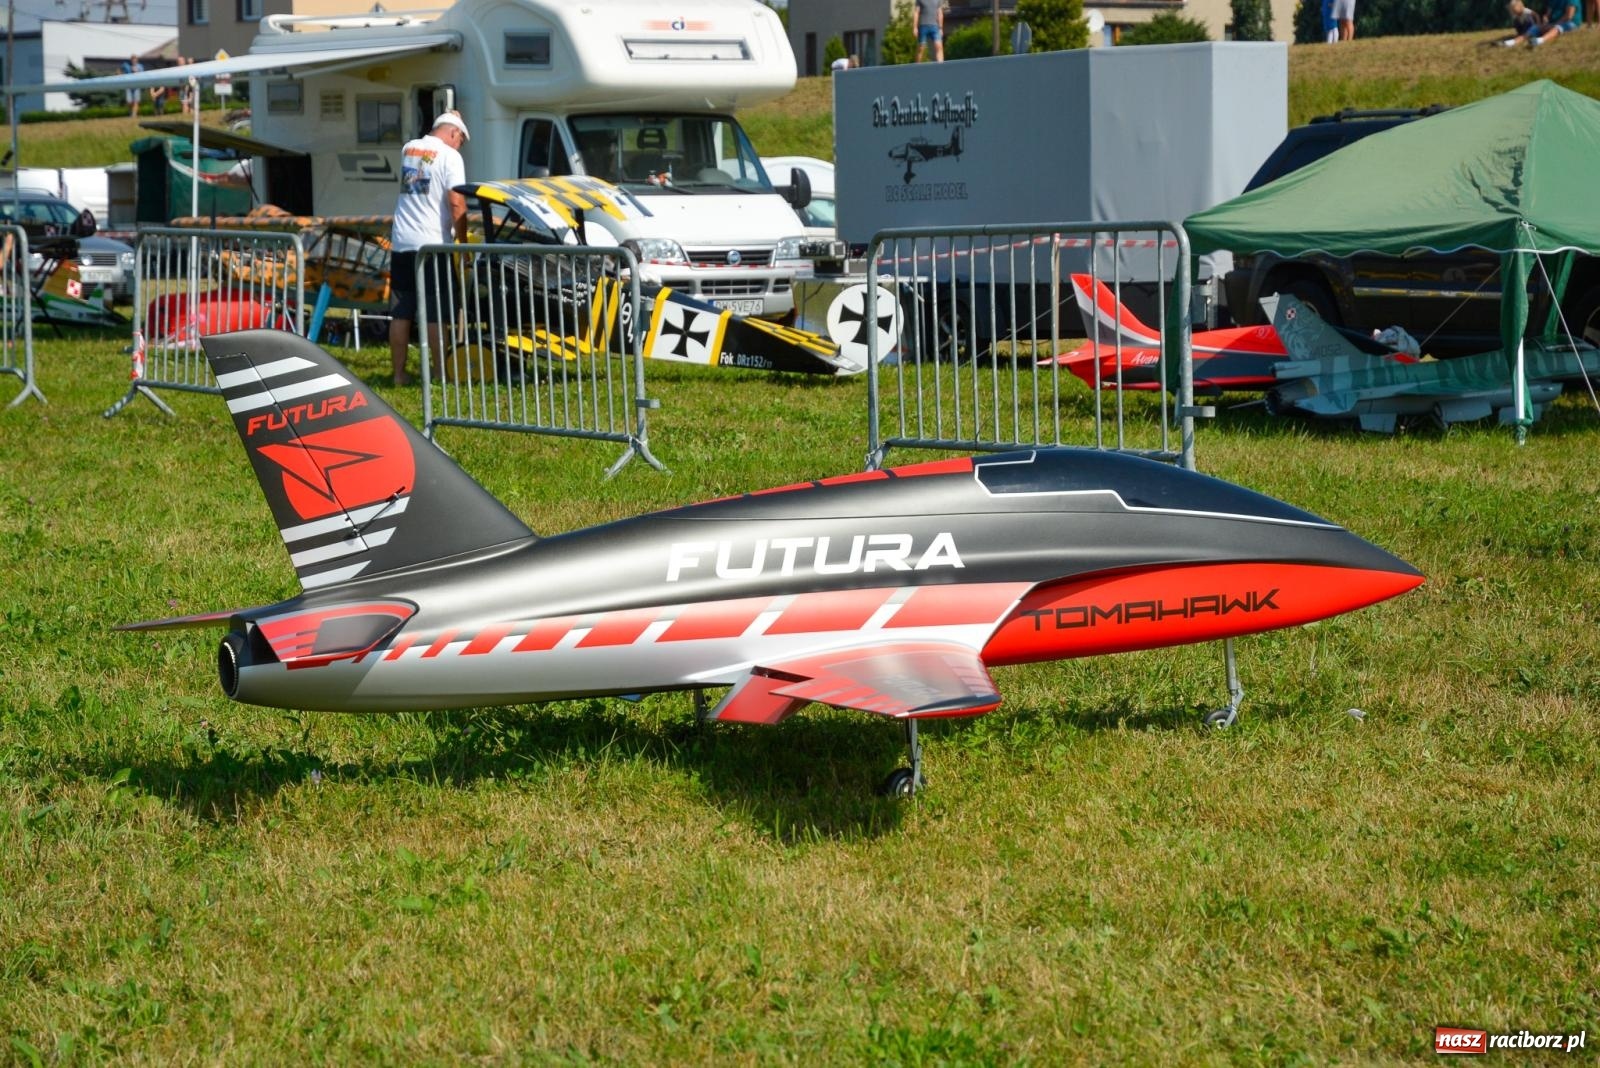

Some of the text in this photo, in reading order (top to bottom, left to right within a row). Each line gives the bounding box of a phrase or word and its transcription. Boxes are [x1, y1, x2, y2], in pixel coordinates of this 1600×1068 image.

[873, 96, 889, 128] Die
[931, 91, 978, 129] Luftwaffe
[933, 182, 968, 200] MODEL
[1131, 351, 1159, 365] Avan
[247, 391, 368, 436] FUTURA
[666, 532, 966, 582] FUTURA
[1020, 588, 1280, 631] TOMAHAWK
